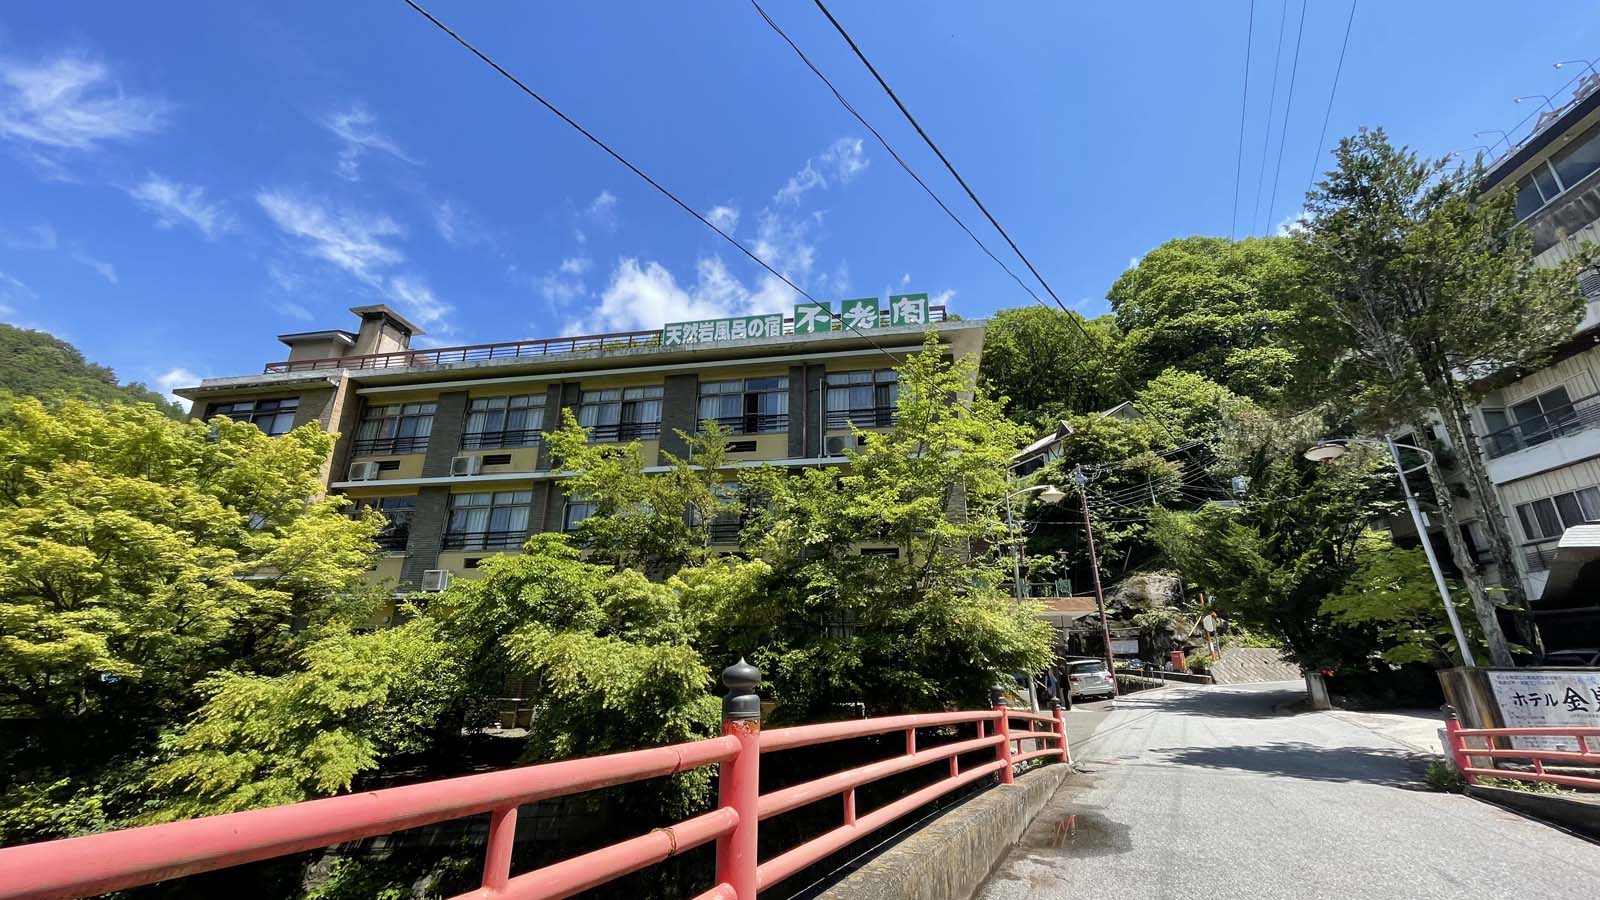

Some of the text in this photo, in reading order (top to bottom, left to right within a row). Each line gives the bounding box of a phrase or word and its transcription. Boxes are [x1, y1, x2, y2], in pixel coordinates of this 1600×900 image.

[665, 316, 781, 346] 天然岩風呂の宿
